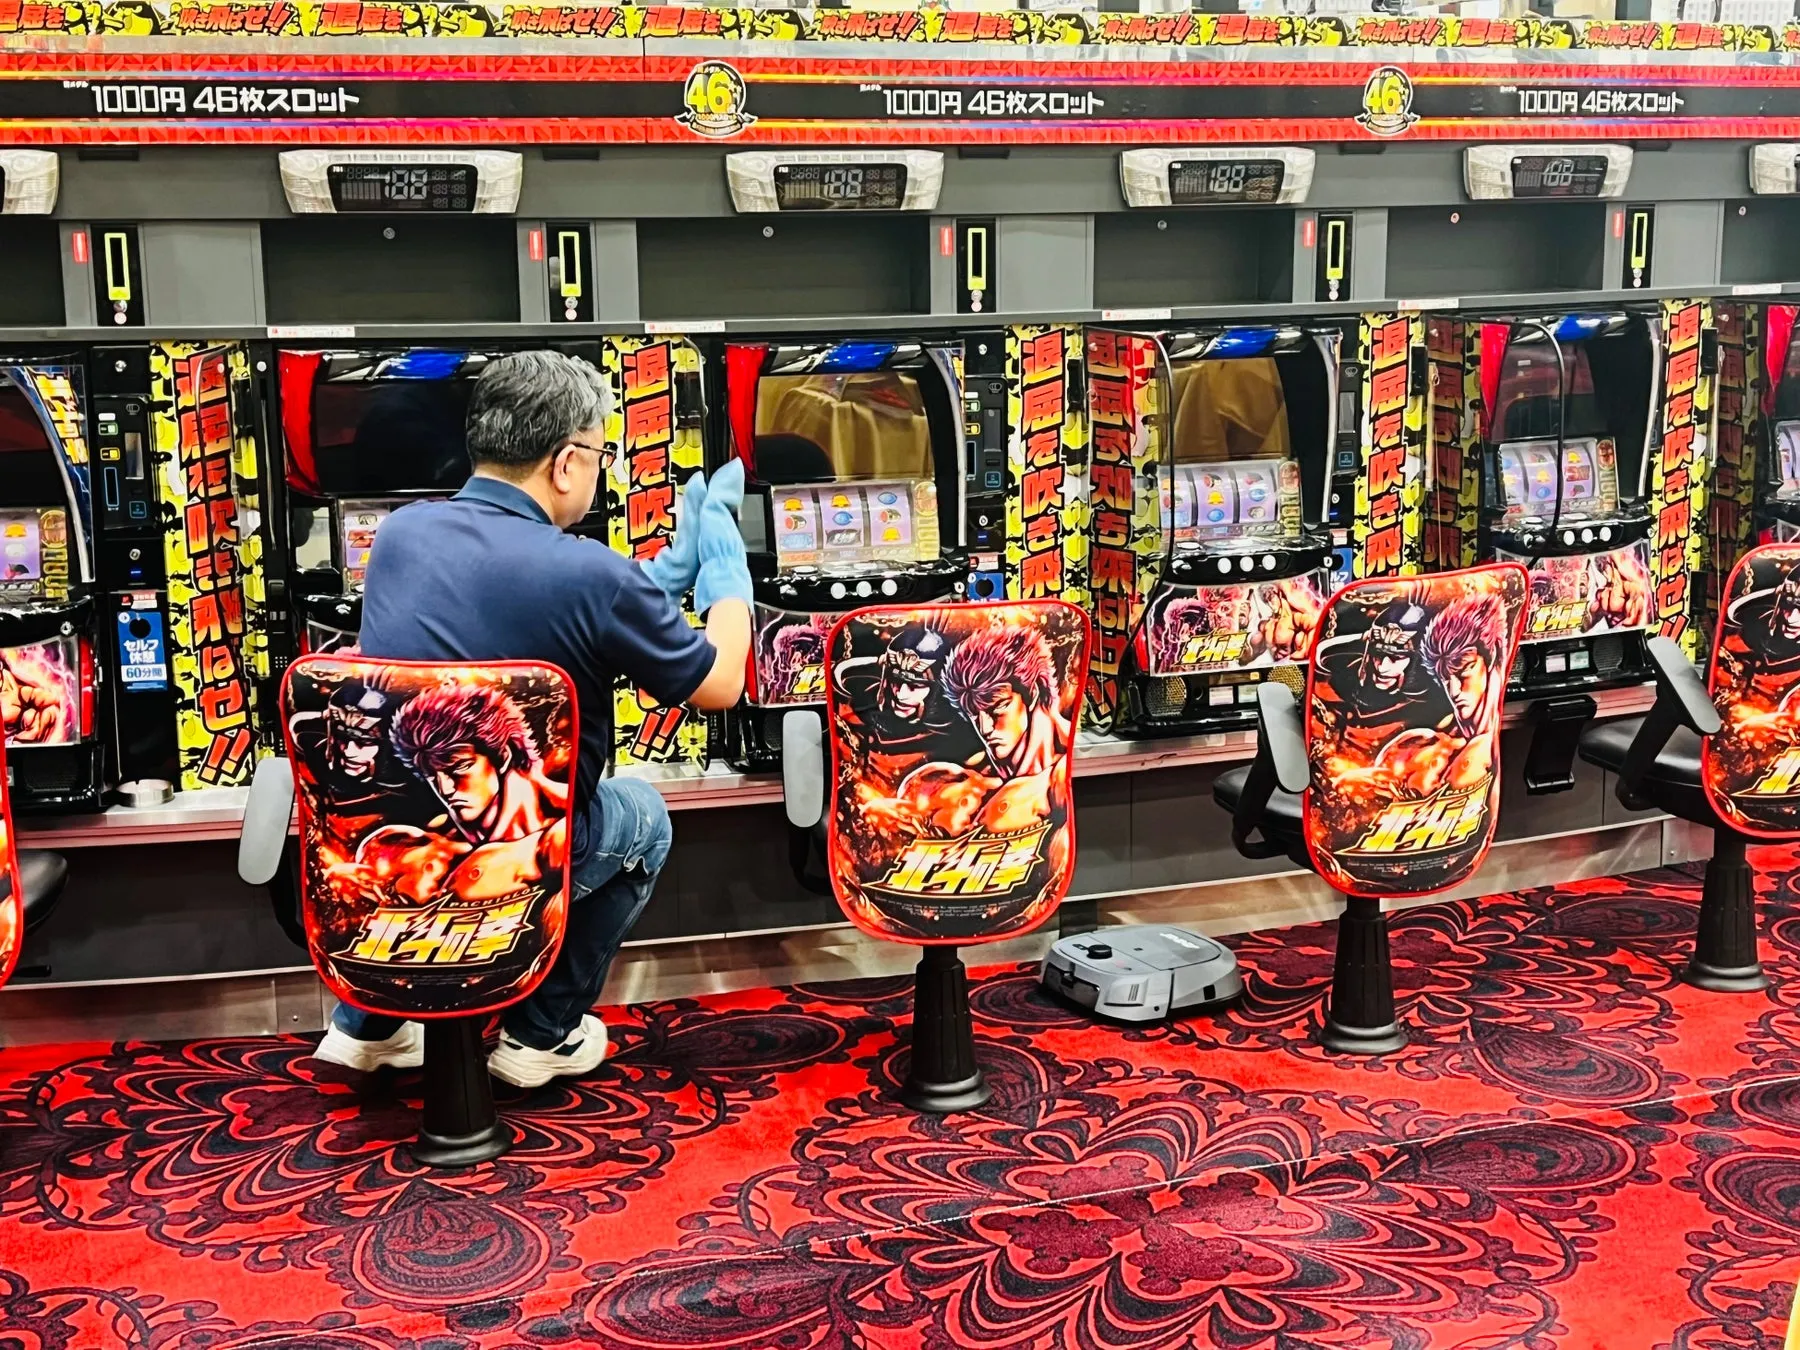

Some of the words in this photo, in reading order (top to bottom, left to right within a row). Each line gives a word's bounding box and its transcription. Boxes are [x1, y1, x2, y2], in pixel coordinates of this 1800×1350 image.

[317, 1, 404, 34] 退屈を
[641, 6, 722, 37] 退屈を
[91, 86, 187, 113] 1000円
[193, 86, 360, 112] 46枚スロット
[687, 70, 733, 114] 46
[883, 89, 962, 114] 1000円
[967, 90, 1105, 115] 46枚スロット
[1365, 75, 1402, 114] 46
[1518, 89, 1578, 112] 1000円
[1581, 90, 1684, 113] 46枚スロット
[123, 639, 159, 652] セルフ
[126, 667, 163, 679] 60分間
[1362, 780, 1490, 853] 北斗の拳
[887, 828, 1046, 894] 北斗の拳
[448, 884, 541, 908] PACHISLOT
[352, 897, 529, 963] 北斗の拳
